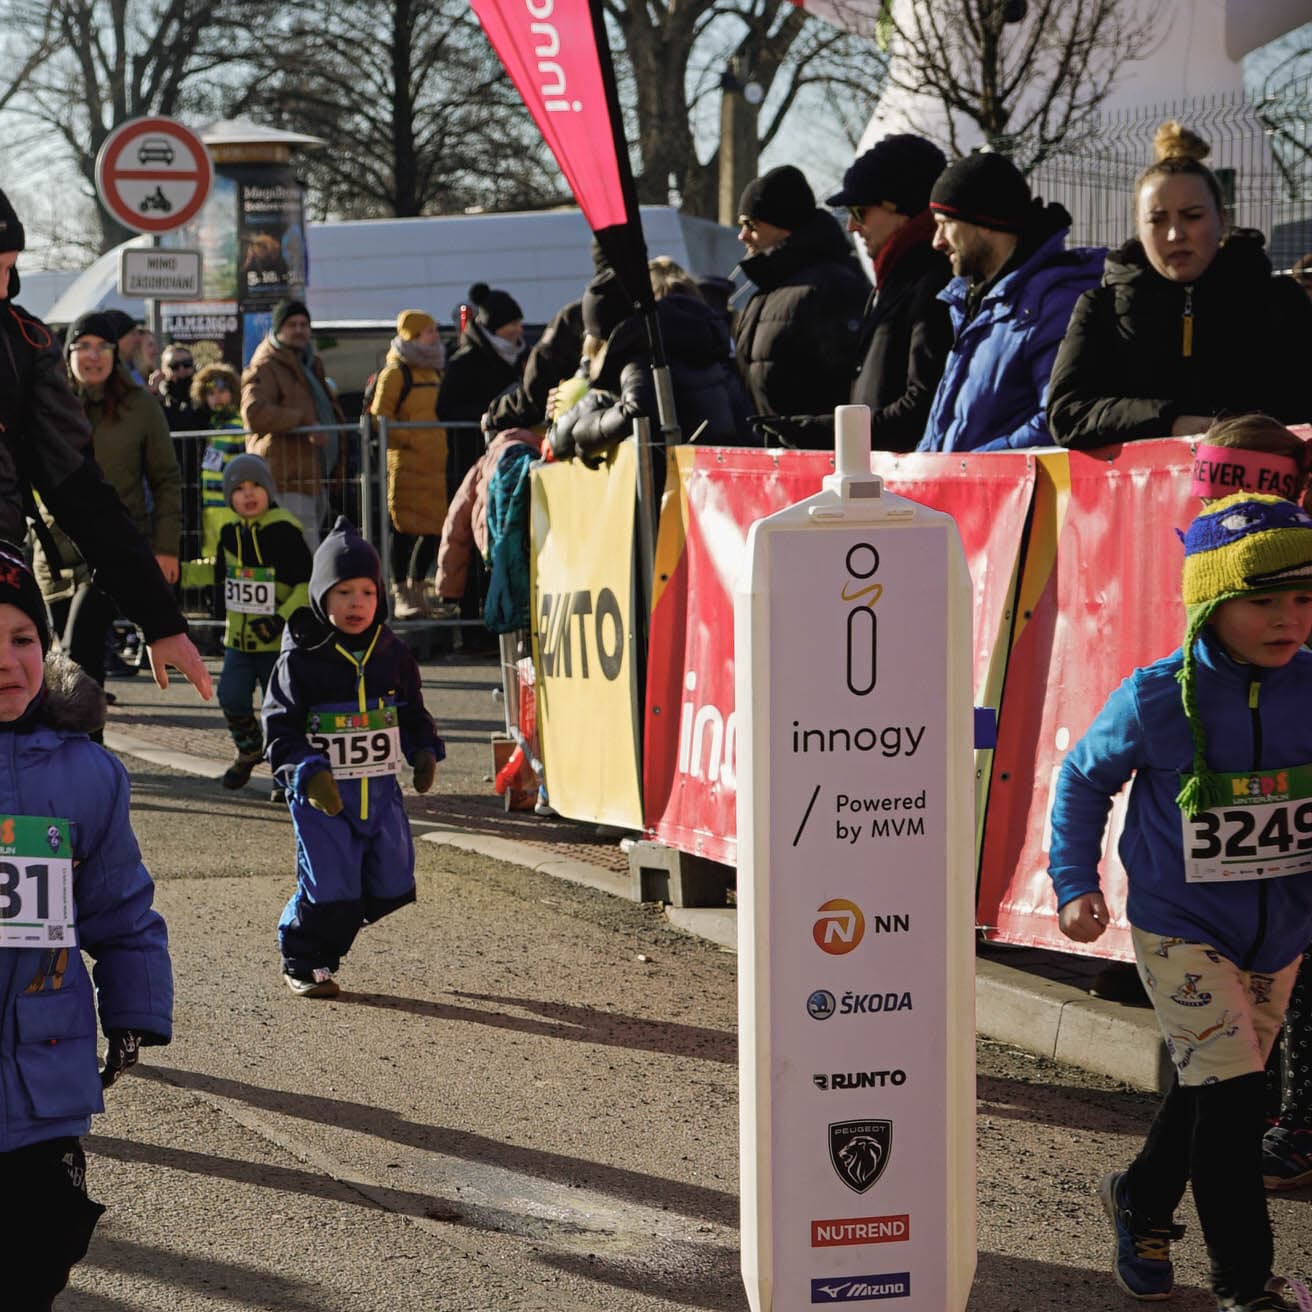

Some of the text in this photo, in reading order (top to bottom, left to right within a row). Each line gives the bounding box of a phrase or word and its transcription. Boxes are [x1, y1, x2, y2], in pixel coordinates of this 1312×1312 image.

[226, 581, 268, 604] 3150
[792, 721, 926, 757] innogy
[836, 790, 927, 813] Powered
[836, 818, 925, 844] by MVM
[1190, 801, 1312, 859] 3249
[875, 914, 910, 933] NN
[840, 991, 913, 1014] ŠKODA
[831, 1070, 906, 1090] RUNTO
[834, 1125, 886, 1135] PEUGEOT
[817, 1220, 905, 1241] NUTREND
